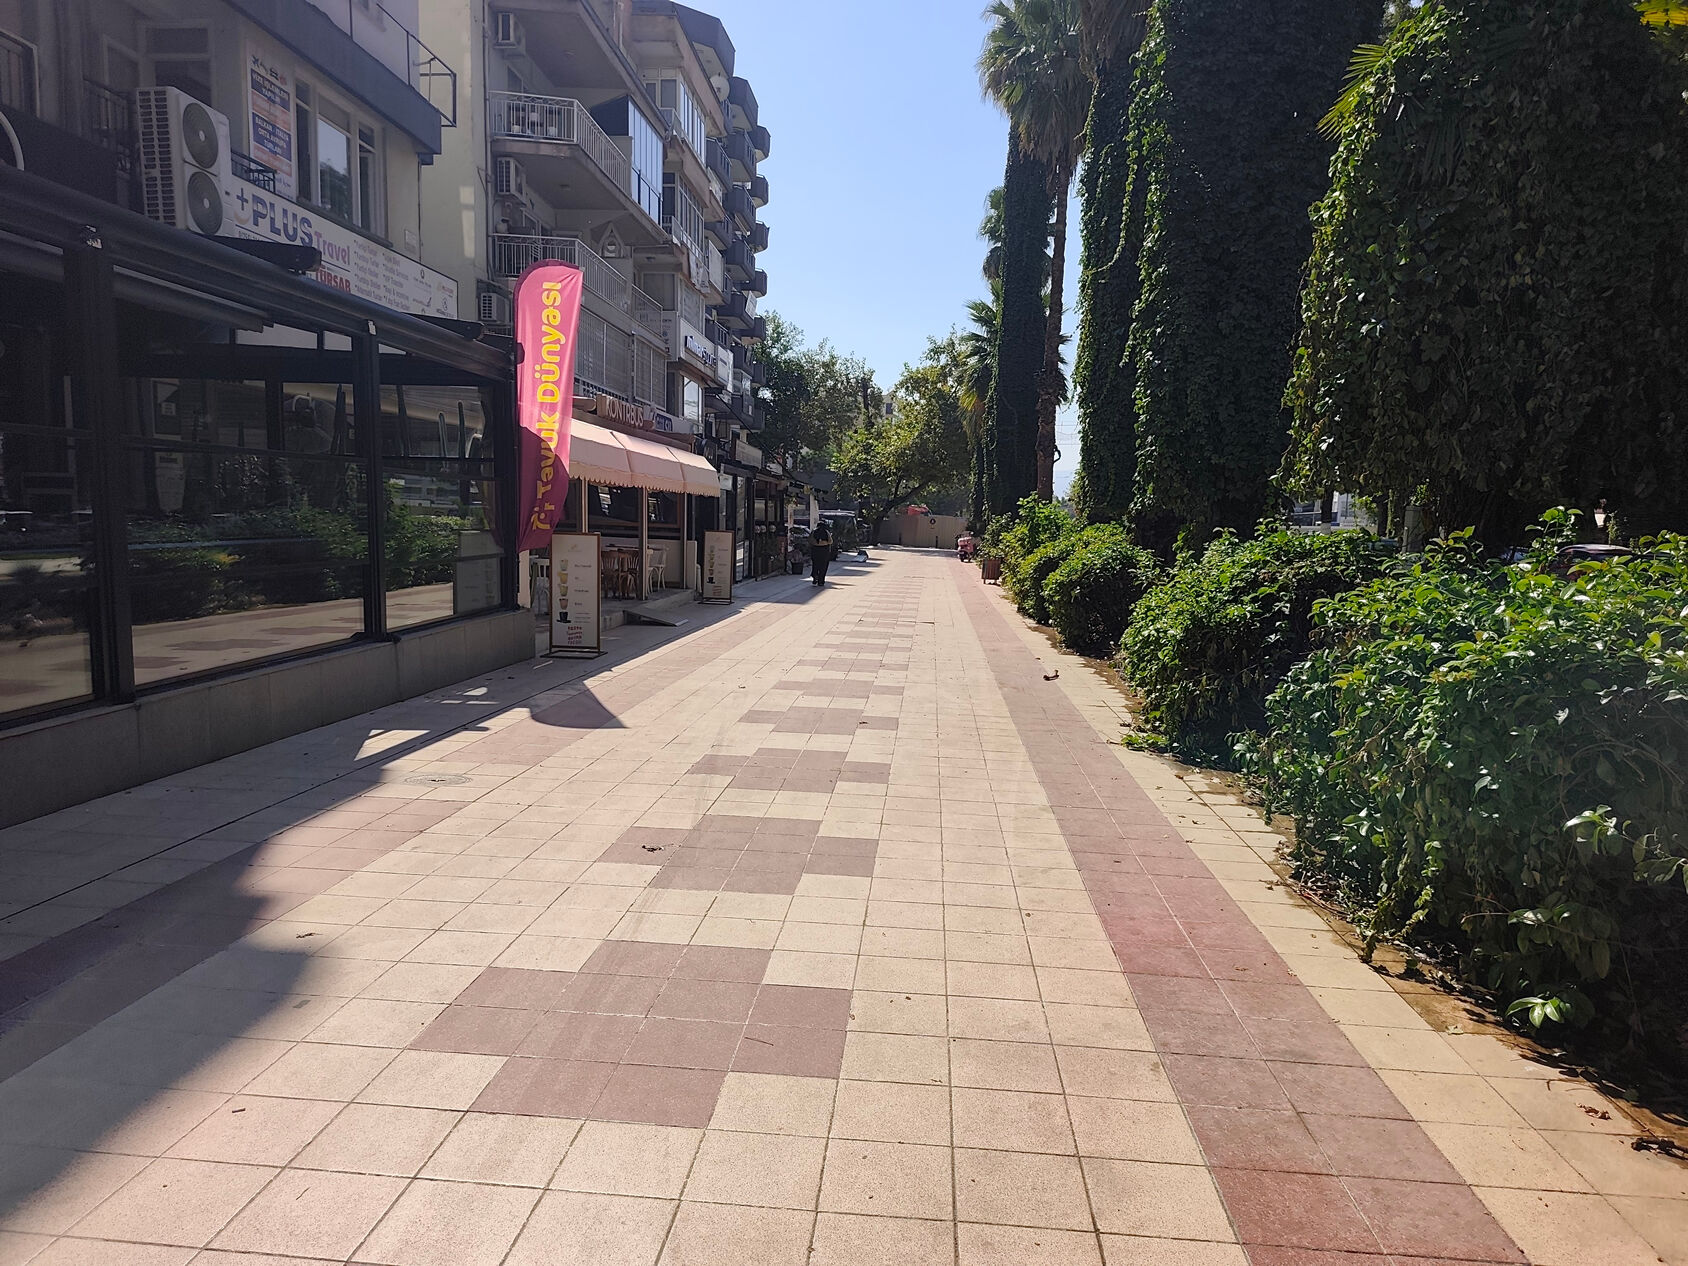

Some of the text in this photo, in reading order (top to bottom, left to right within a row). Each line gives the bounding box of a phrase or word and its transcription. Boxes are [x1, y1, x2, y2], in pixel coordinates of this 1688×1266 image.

[314, 230, 351, 265] Travel
[534, 281, 566, 499] Tavuk Dünyası
